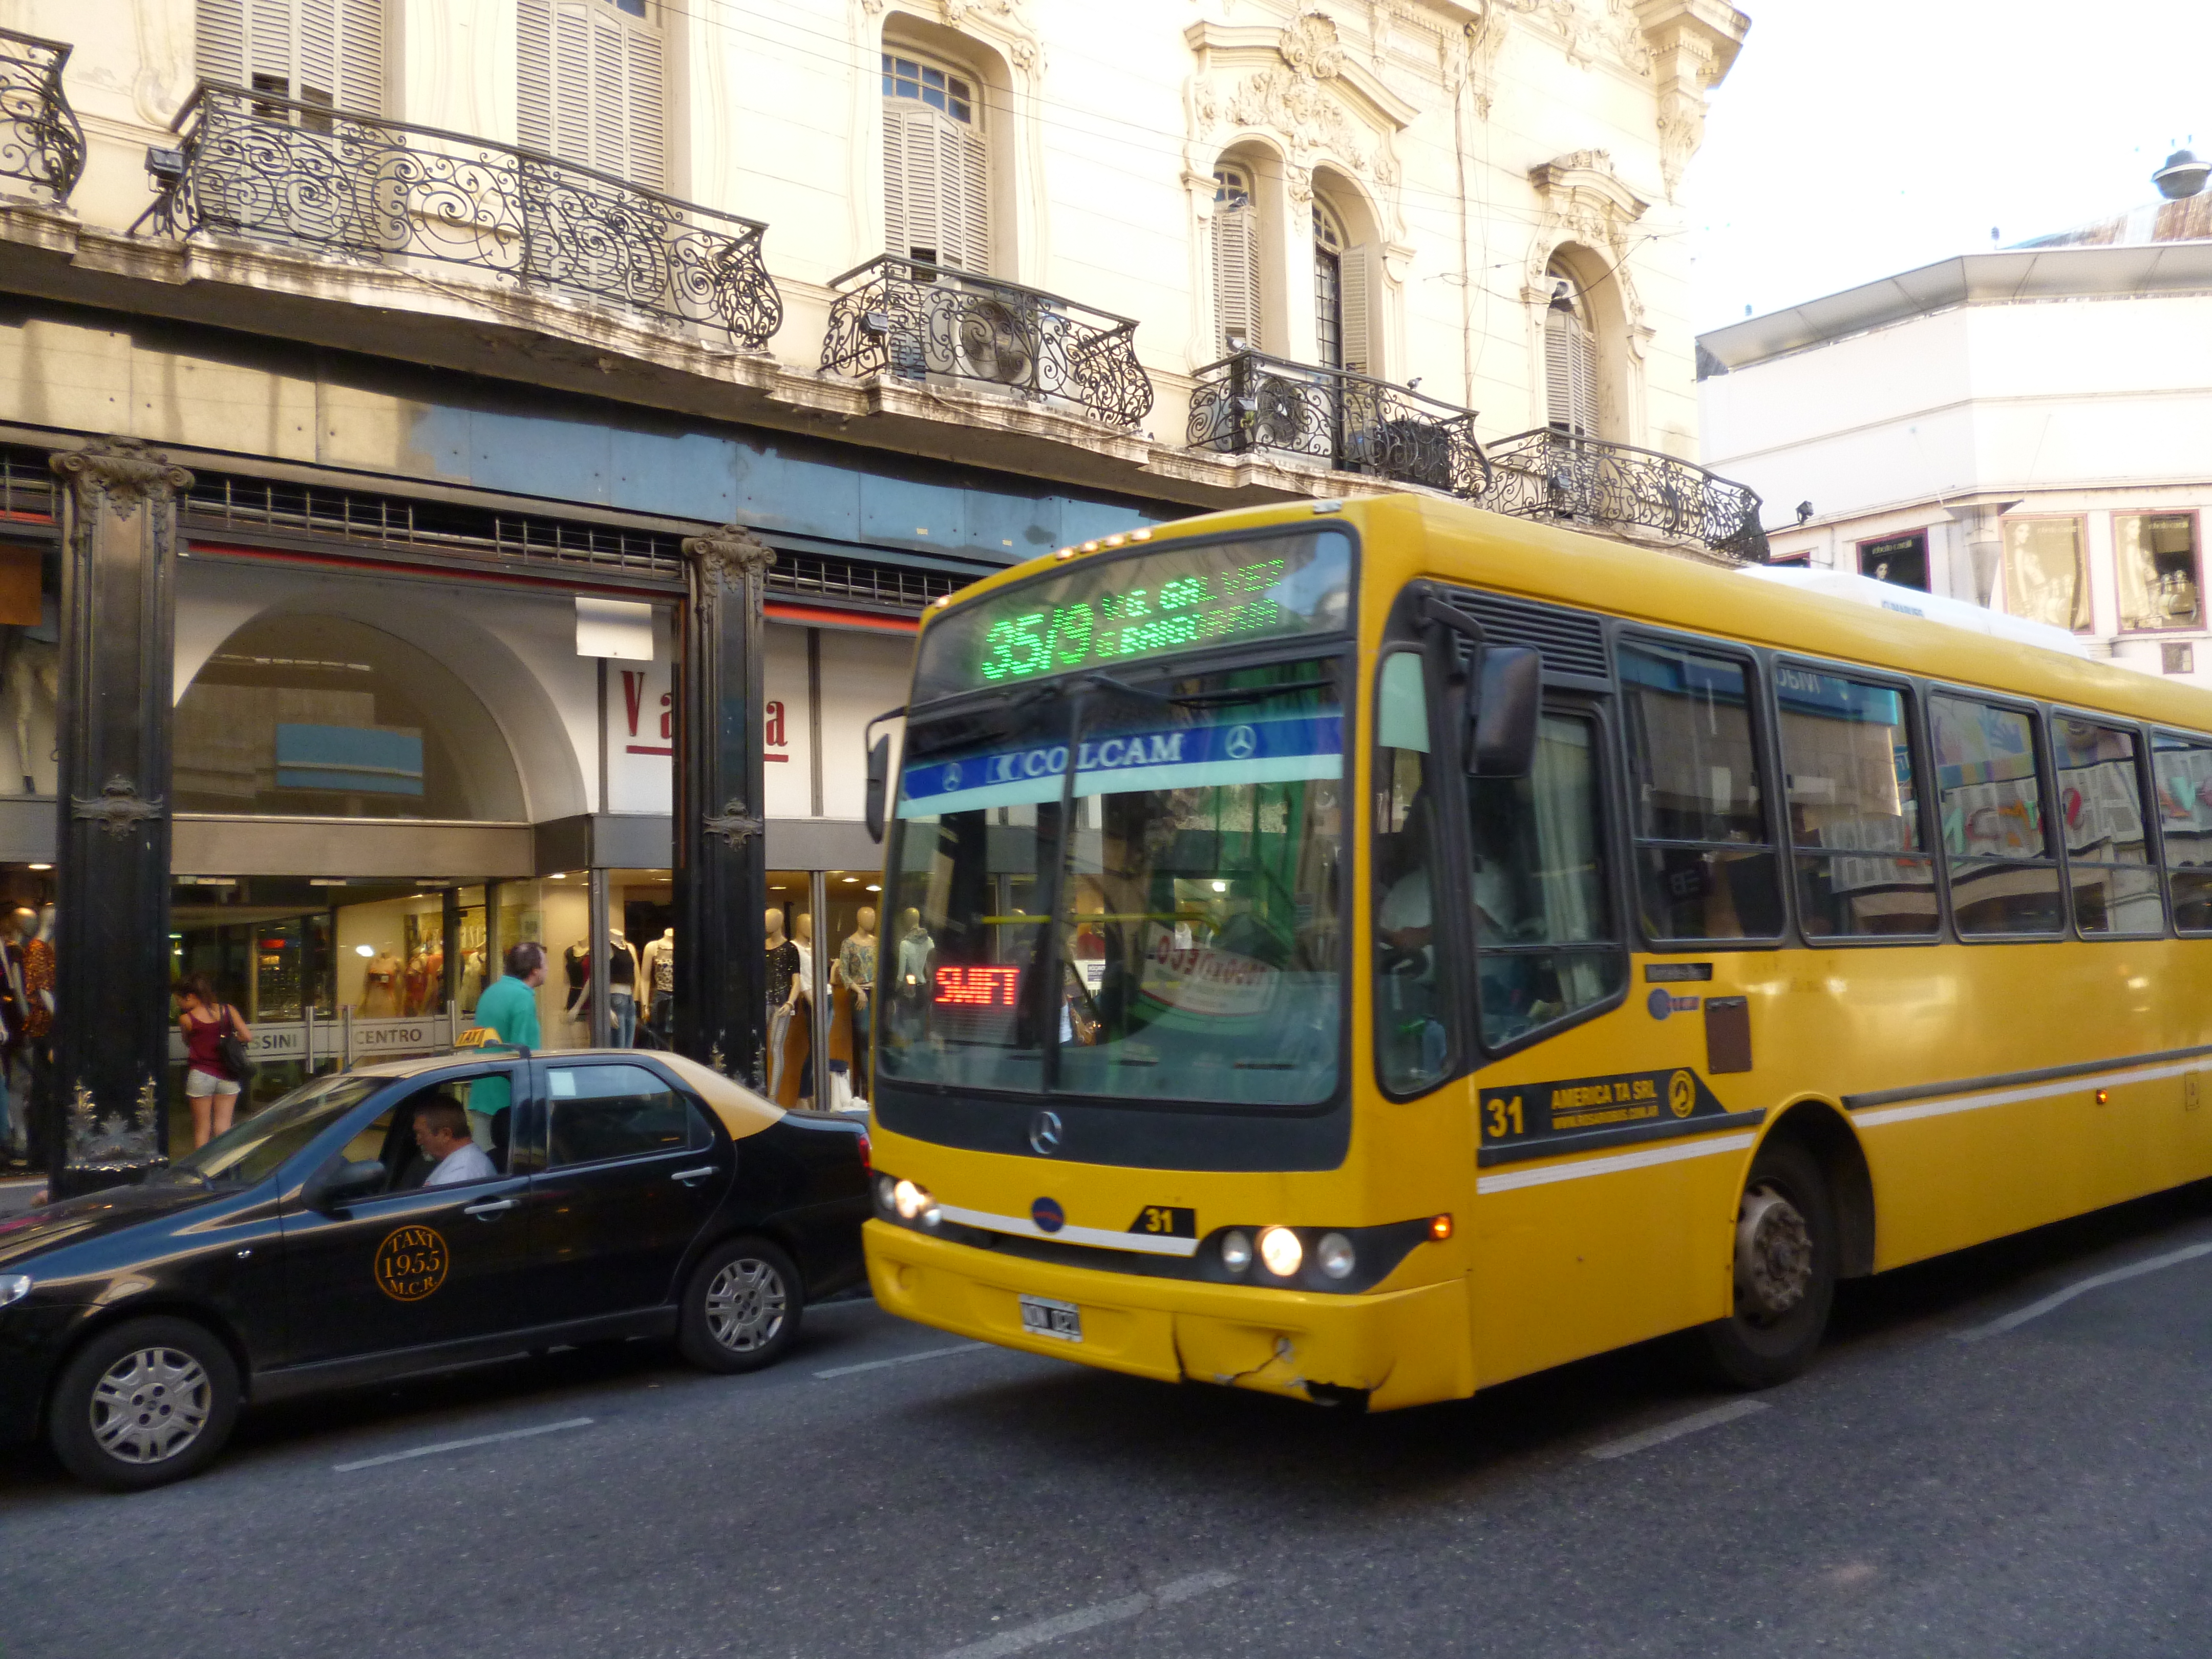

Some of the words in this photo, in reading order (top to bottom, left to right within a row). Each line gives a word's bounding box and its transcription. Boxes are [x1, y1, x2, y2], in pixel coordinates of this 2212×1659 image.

[982, 603, 1094, 679] 35/9
[353, 1029, 422, 1045] CENTRO
[1486, 1095, 1524, 1138] 31
[1145, 1208, 1174, 1233] 31
[389, 1230, 435, 1253] TAXI
[385, 1250, 440, 1278] 1955
